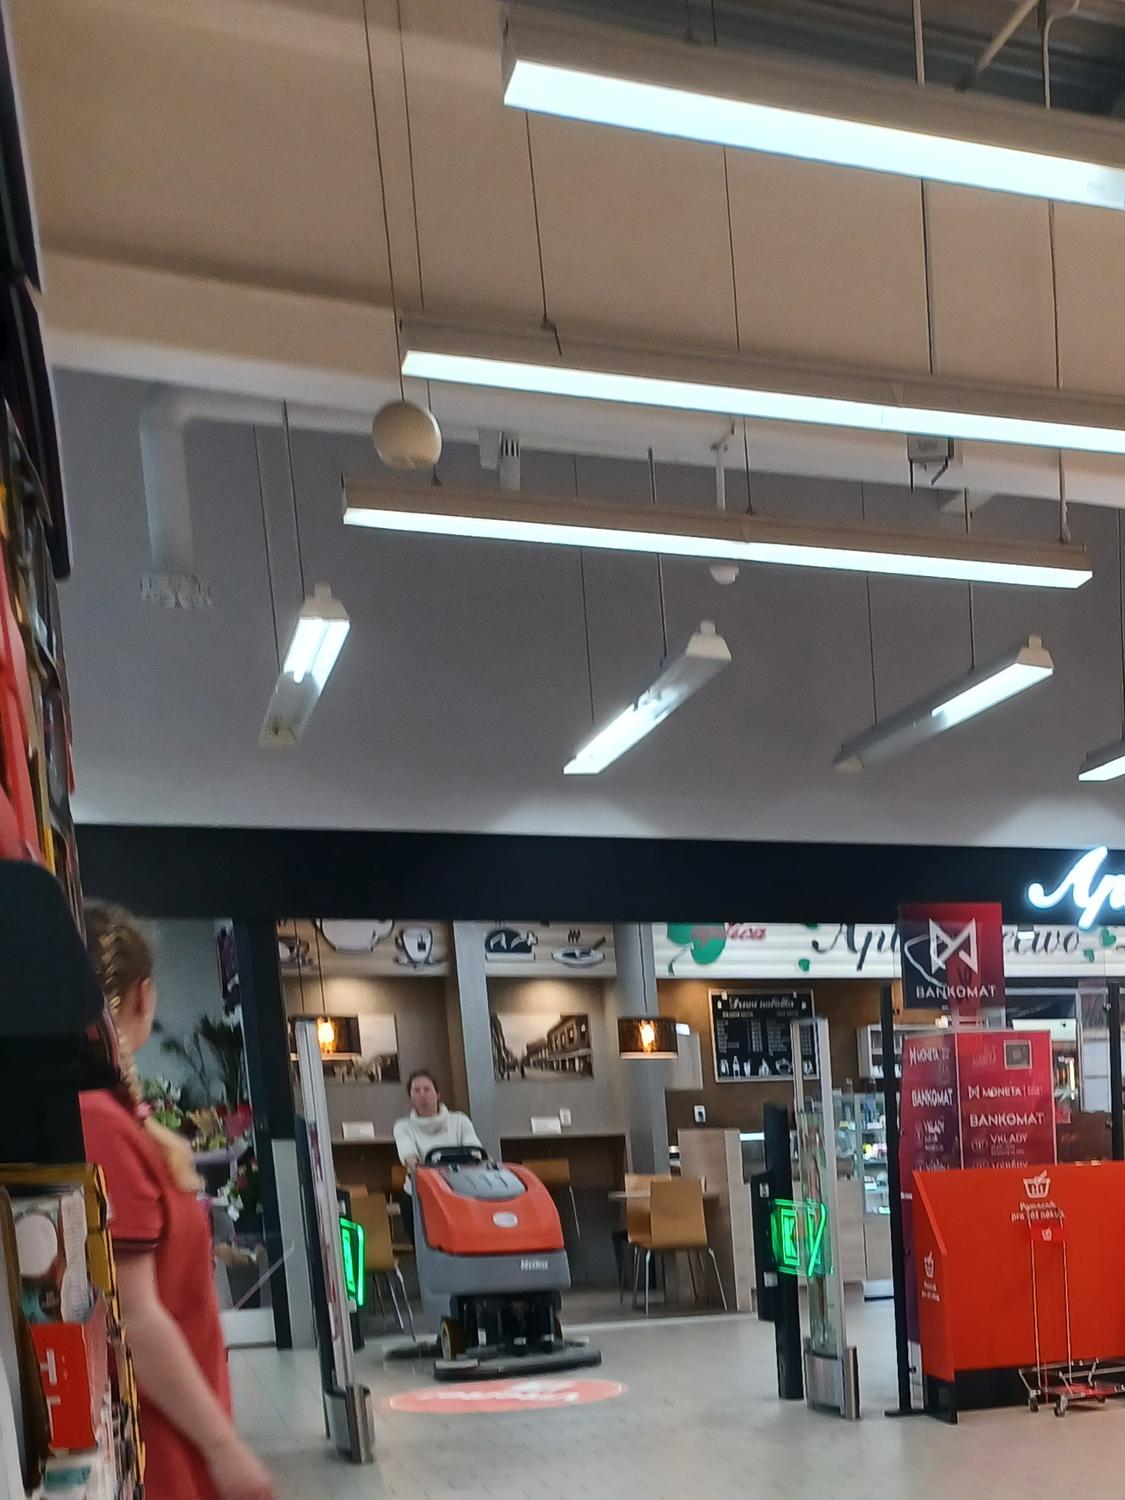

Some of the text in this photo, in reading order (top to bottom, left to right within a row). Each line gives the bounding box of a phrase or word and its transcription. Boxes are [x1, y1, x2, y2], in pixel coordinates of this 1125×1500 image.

[915, 984, 997, 1000] BANKOMAT
[911, 1087, 954, 1107] BANKOMAT
[982, 1085, 1022, 1098] MONETA
[969, 1111, 1045, 1128] BANKOMAT
